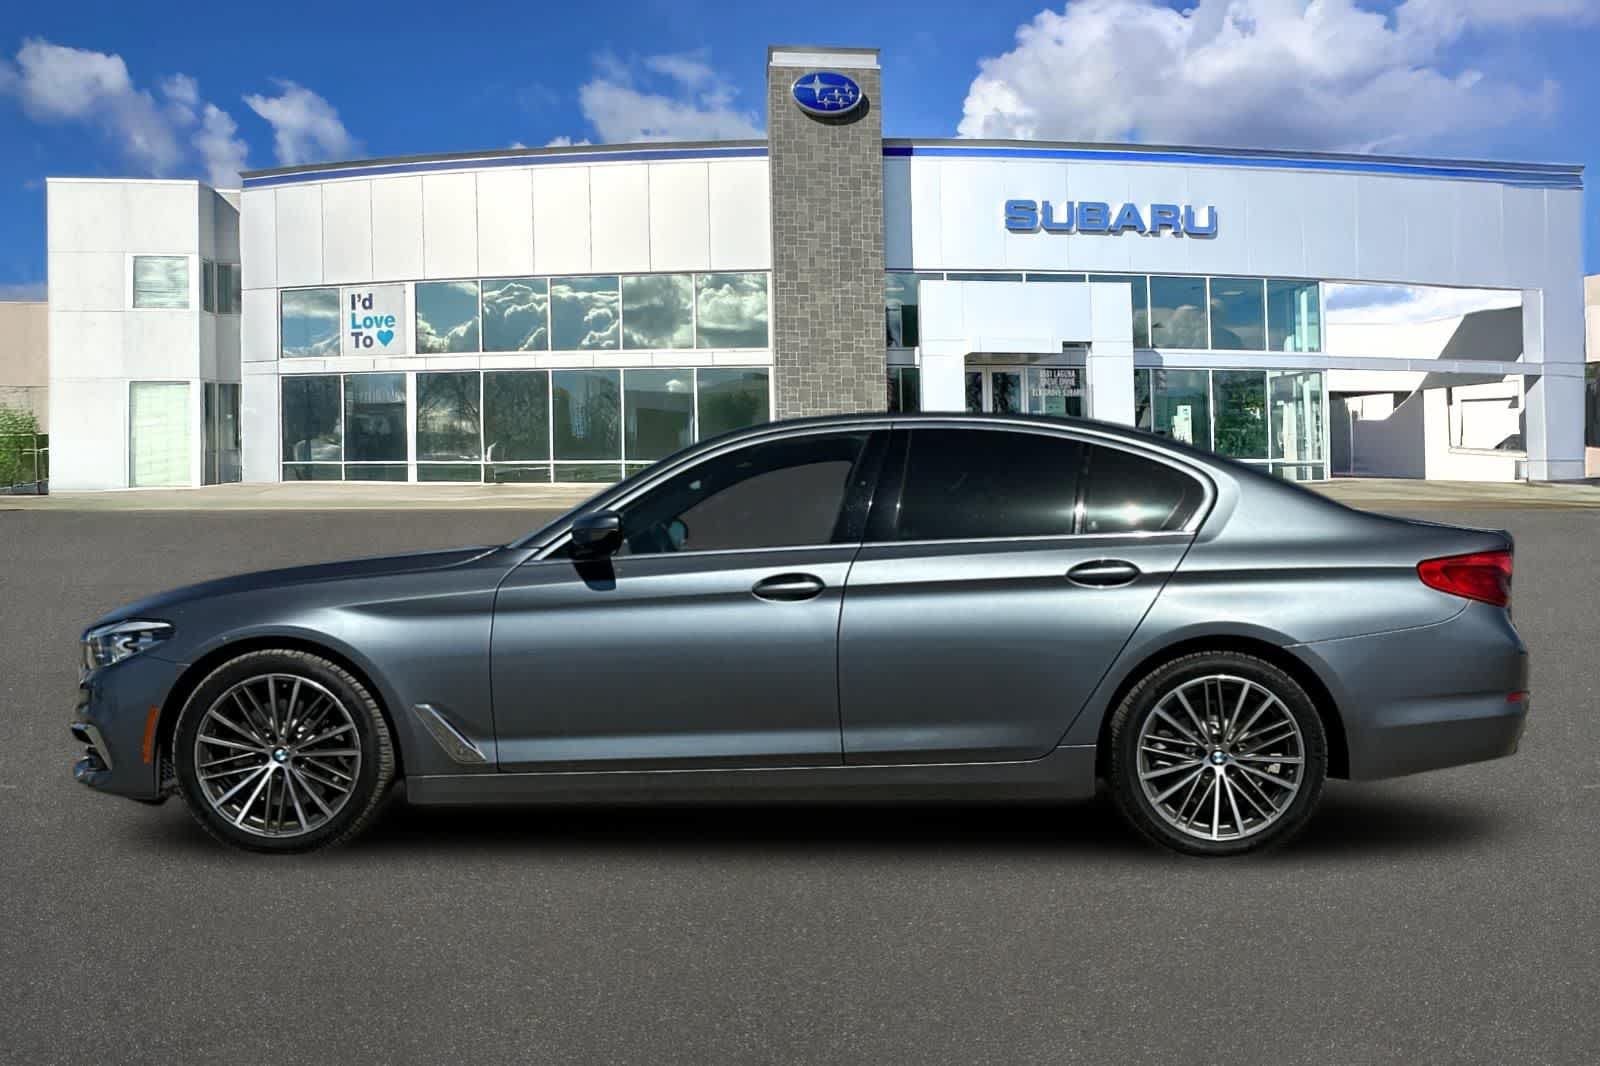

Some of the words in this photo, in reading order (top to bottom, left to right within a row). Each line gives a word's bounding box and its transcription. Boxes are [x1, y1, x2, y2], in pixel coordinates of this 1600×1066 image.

[1005, 199, 1217, 237] SUBARU
[351, 293, 373, 310] I'd
[351, 312, 395, 329] Love
[351, 331, 373, 348] To
